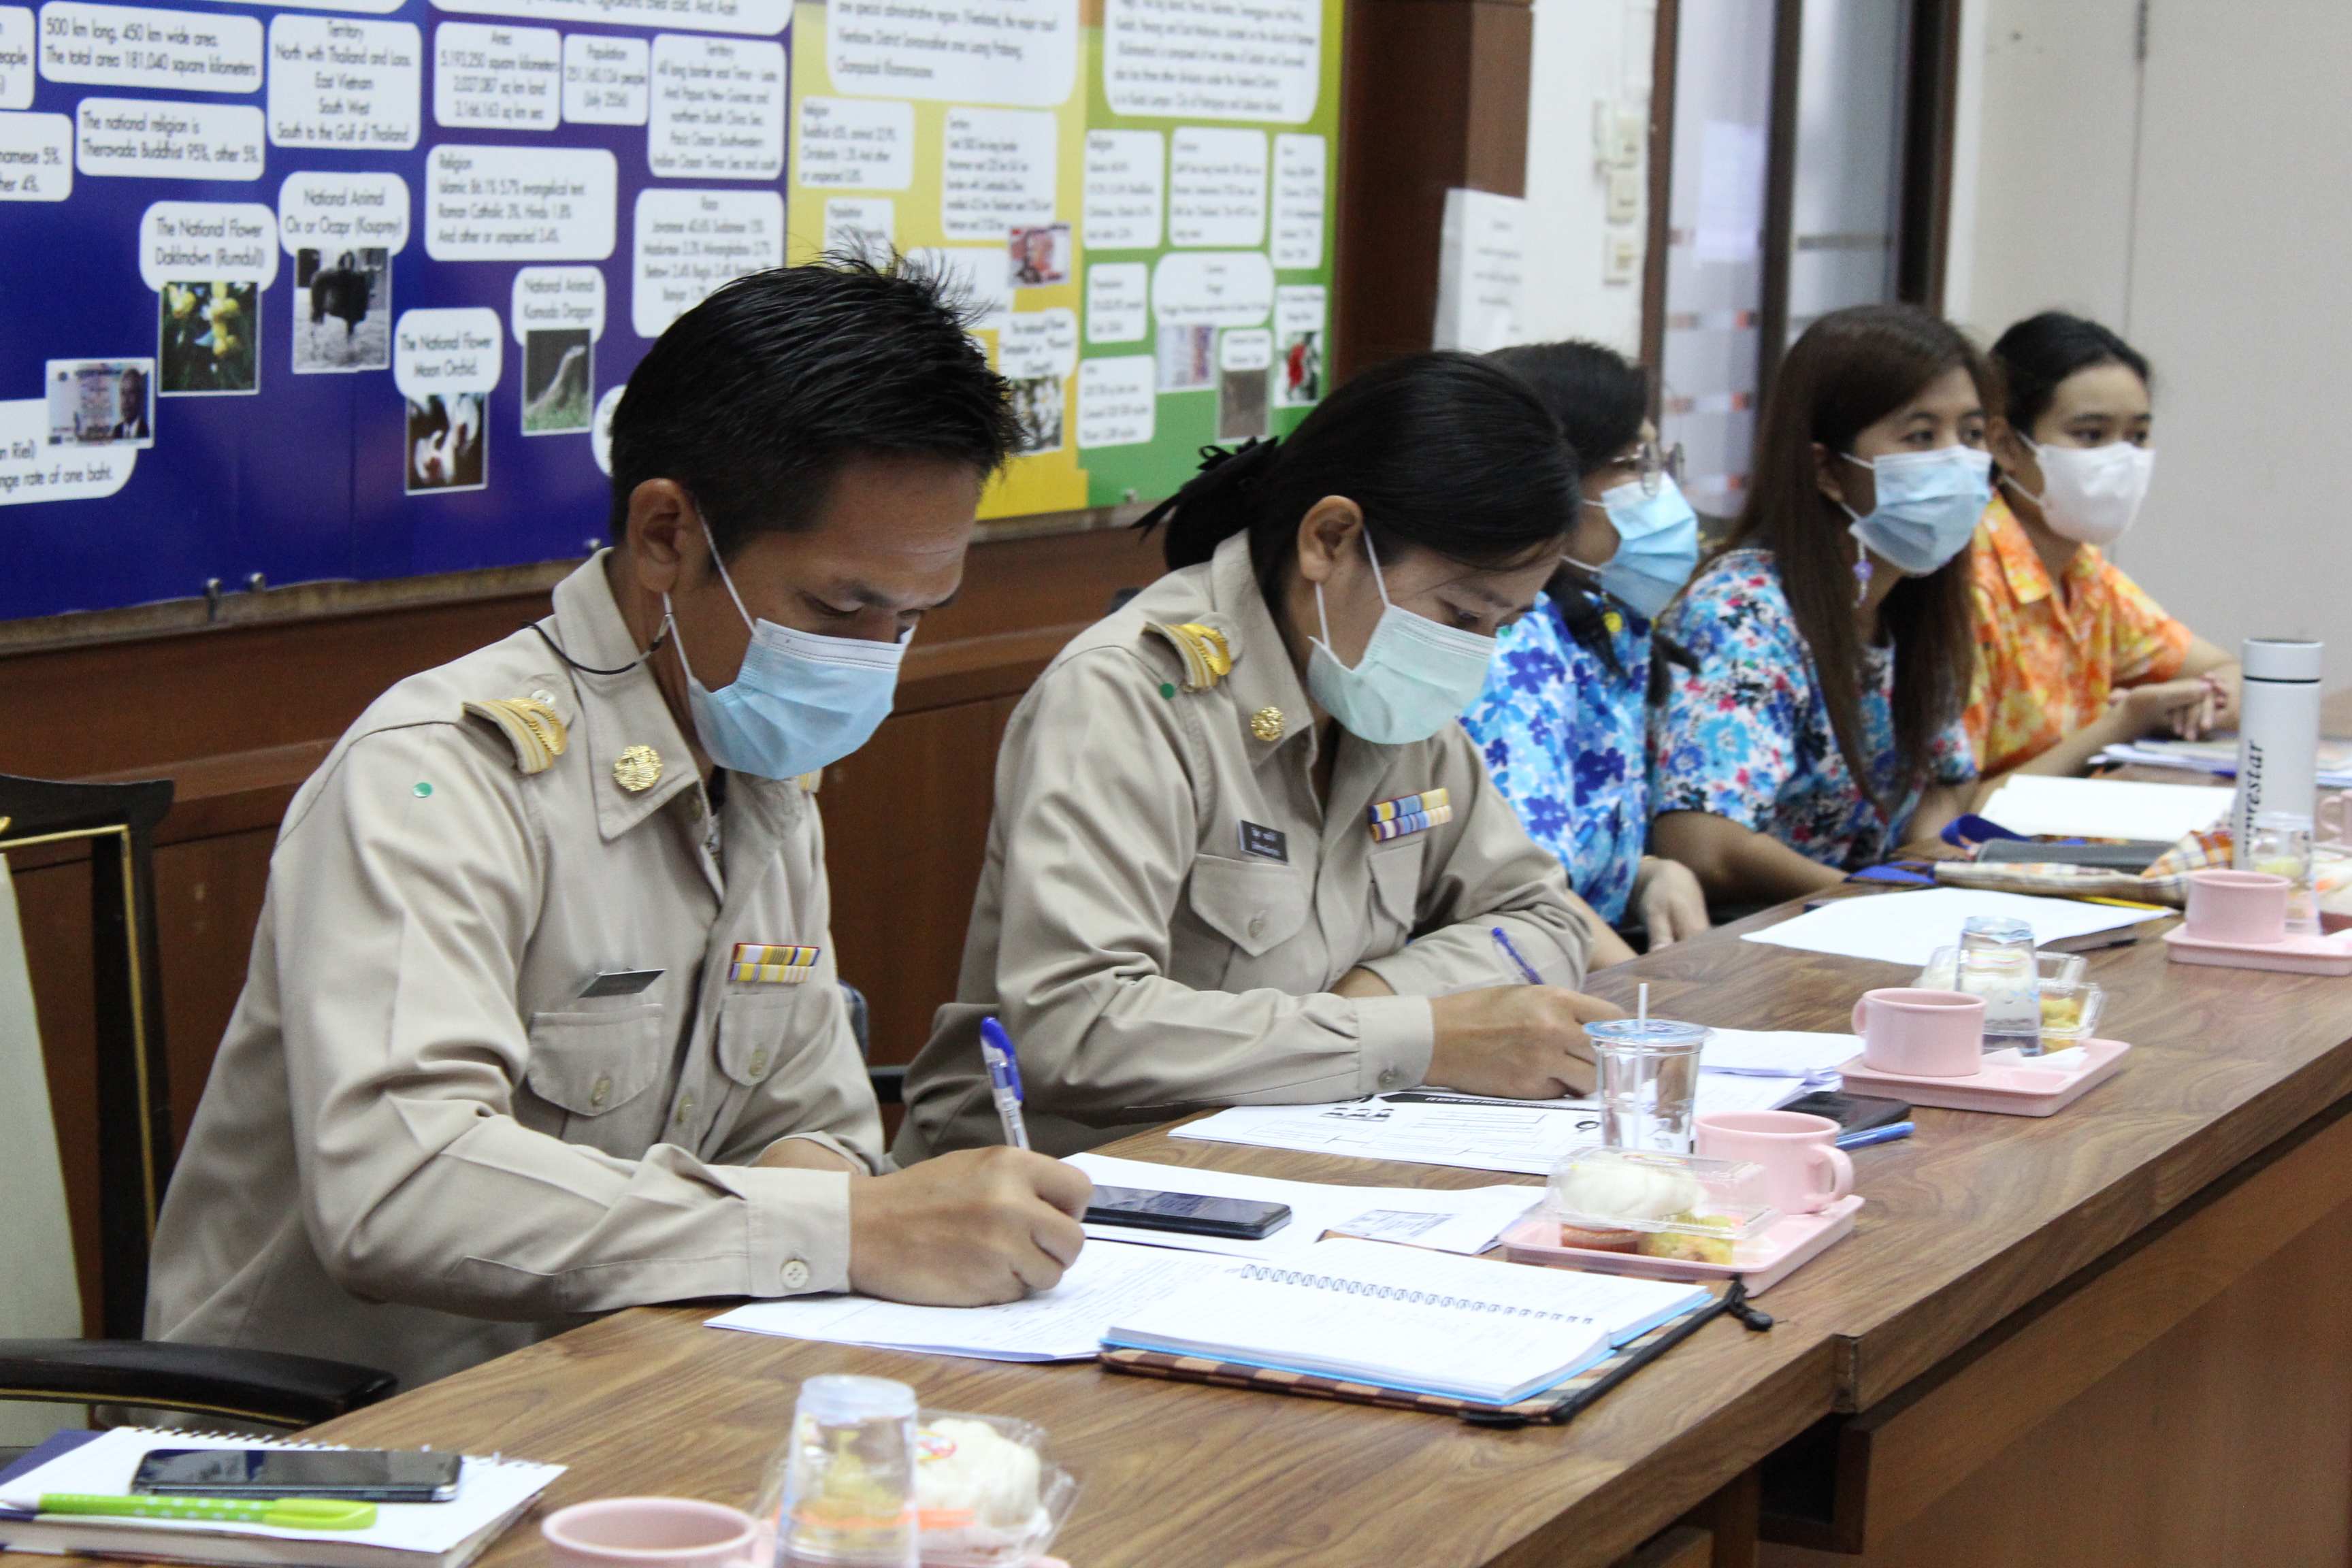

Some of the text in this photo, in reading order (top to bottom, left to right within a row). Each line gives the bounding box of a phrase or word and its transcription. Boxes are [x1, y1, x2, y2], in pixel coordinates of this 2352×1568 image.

[47, 17, 69, 36] 500
[72, 18, 88, 37] km
[122, 23, 143, 42] 450
[147, 24, 163, 42] km
[167, 27, 190, 46] wide
[328, 20, 364, 44] Territory
[46, 44, 65, 65] The
[69, 47, 91, 66] total
[95, 54, 120, 68] area
[172, 59, 206, 77] square
[275, 43, 301, 61] North
[305, 42, 324, 61] with
[329, 45, 366, 64] Thailand
[370, 46, 387, 66] and
[315, 71, 374, 90] East Vietnam
[319, 96, 344, 115] South
[82, 110, 200, 138] The national religion is
[277, 120, 409, 142] South to the Gulf of Thailand
[141, 139, 184, 161] Buddhist
[214, 144, 240, 163] other
[304, 187, 386, 208] National Animal
[156, 216, 263, 239] The National Flower
[524, 275, 561, 293] National
[523, 301, 560, 318] Komodo
[400, 330, 493, 352] The National Flower
[24, 470, 45, 486] rate
[48, 463, 61, 485] of
[63, 470, 84, 484] one
